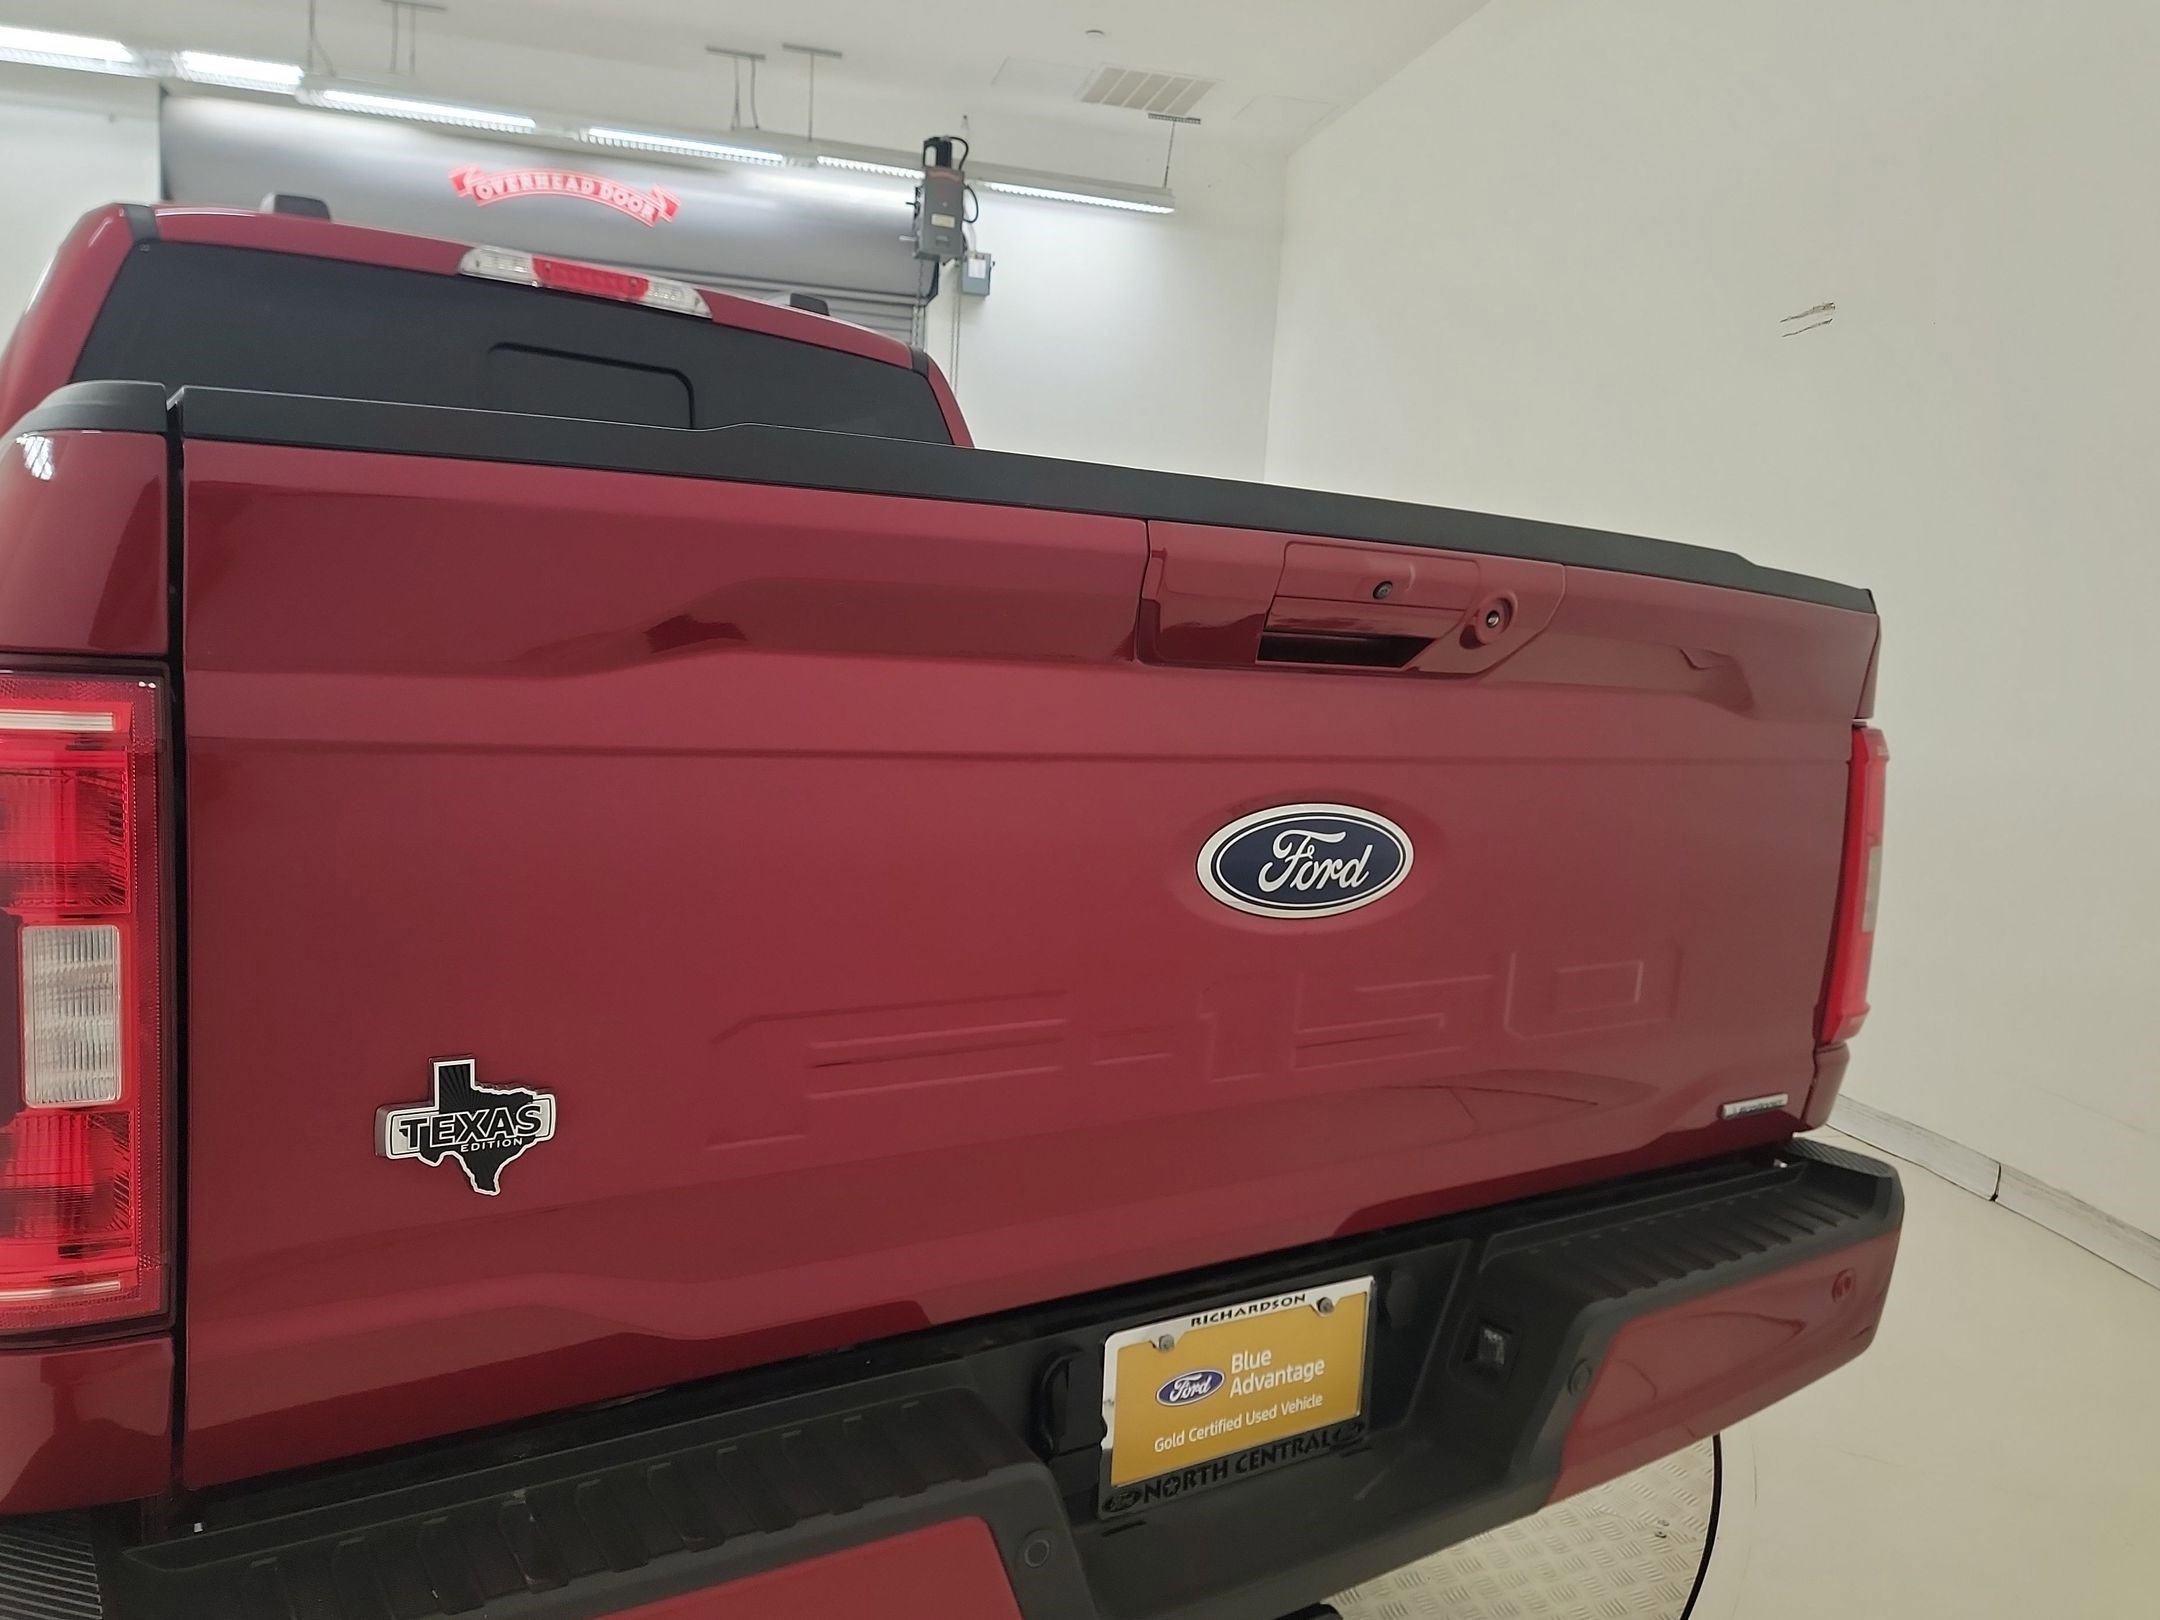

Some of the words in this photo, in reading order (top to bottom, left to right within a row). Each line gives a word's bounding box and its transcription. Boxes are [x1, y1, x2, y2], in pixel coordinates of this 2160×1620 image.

[475, 173, 595, 200] OVERHEAD
[600, 186, 658, 221] DOOR
[1258, 829, 1374, 893] Ford
[399, 1104, 543, 1150] TEXAS
[460, 1137, 523, 1153] EDITION
[1190, 1293, 1307, 1328] RICHARDSON
[1229, 1358, 1326, 1398] Advantage
[1231, 1349, 1273, 1374] Blue
[1169, 1373, 1212, 1402] Ford
[1154, 1430, 1185, 1453] Gold
[1188, 1411, 1242, 1440] Certified
[1246, 1403, 1278, 1426] Used
[1281, 1393, 1324, 1416] Vehicle
[1143, 1459, 1229, 1503] NORTH
[1234, 1430, 1331, 1475] CENTRAL
